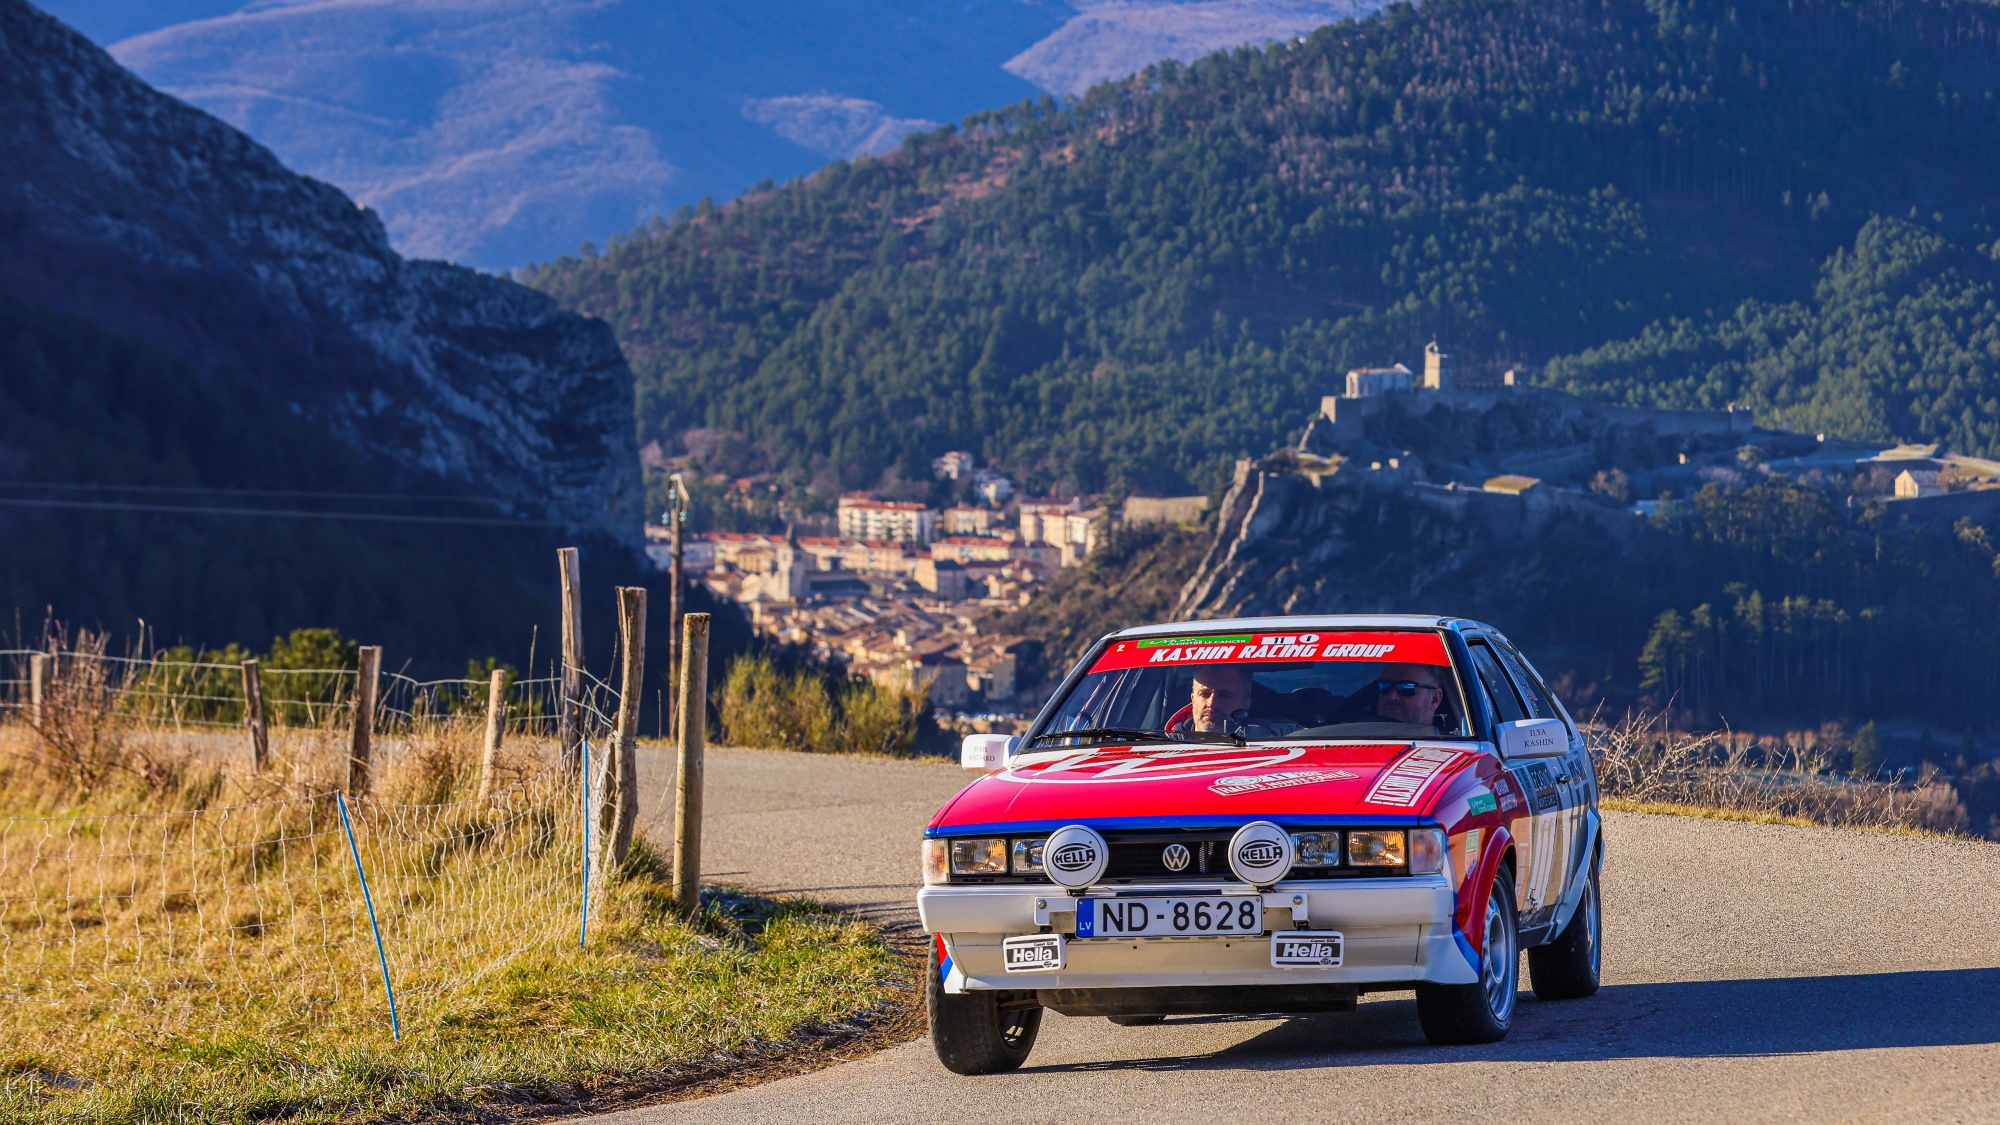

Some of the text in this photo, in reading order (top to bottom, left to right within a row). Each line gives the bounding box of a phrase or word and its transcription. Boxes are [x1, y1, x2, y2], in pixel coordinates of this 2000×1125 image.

[1116, 644, 1126, 652] 2
[1149, 644, 1395, 663] KASHIN RACING GROUP
[1530, 729, 1547, 737] ILYA
[1524, 739, 1554, 748] KASHIN
[1055, 848, 1096, 864] HELLA
[1241, 845, 1283, 860] HELLA
[1079, 922, 1092, 931] LV
[1012, 946, 1053, 963] Hella
[1282, 943, 1333, 957] Hella
